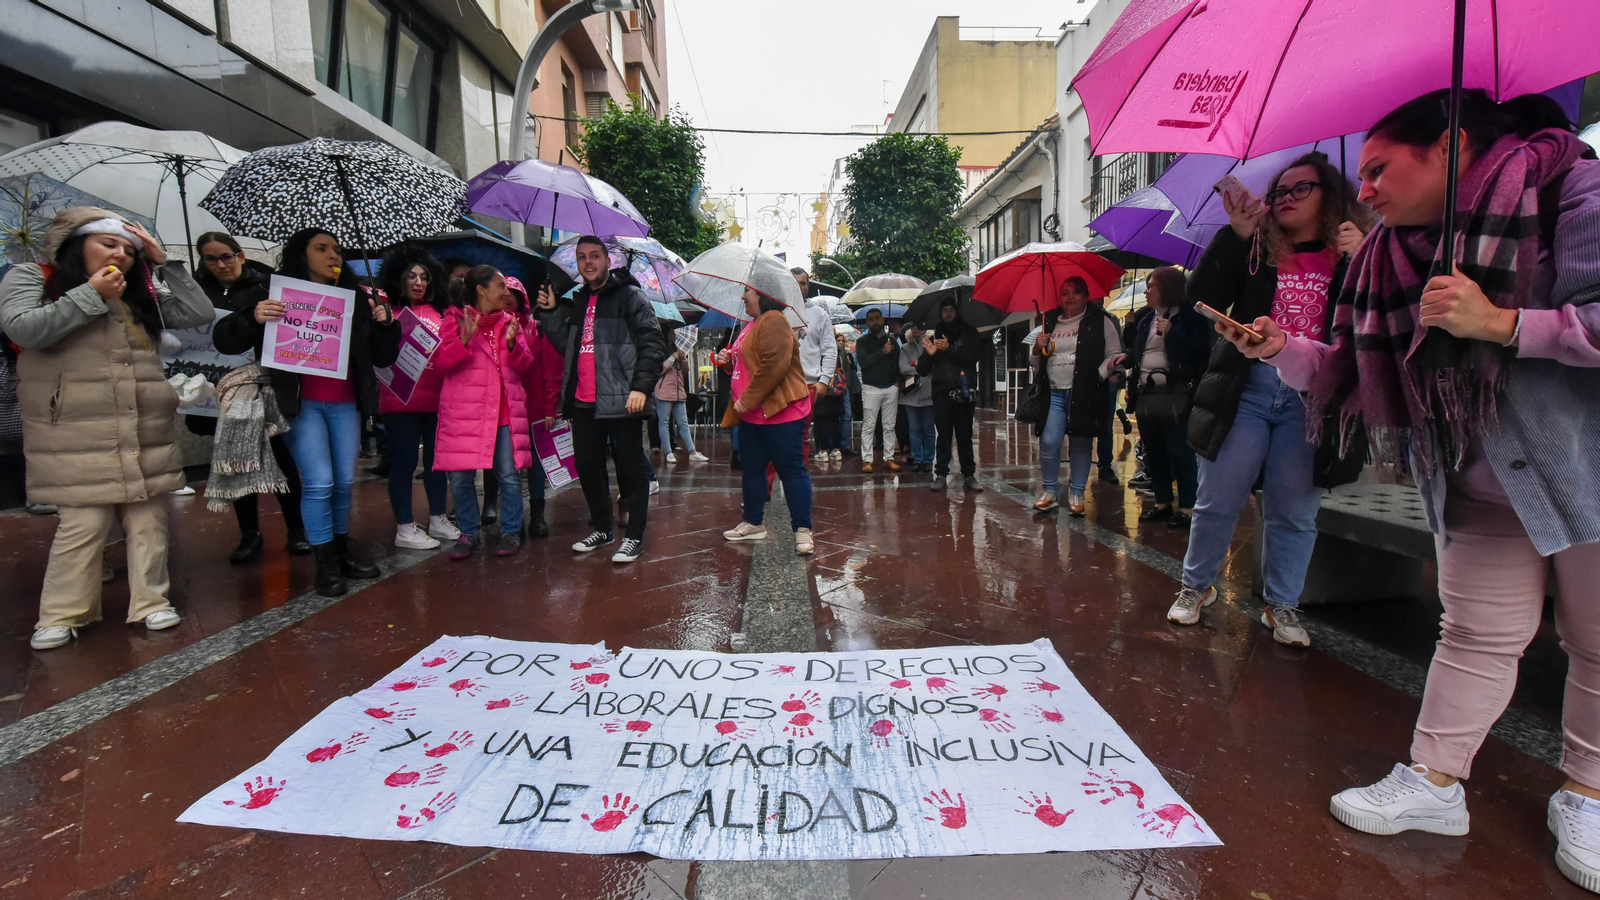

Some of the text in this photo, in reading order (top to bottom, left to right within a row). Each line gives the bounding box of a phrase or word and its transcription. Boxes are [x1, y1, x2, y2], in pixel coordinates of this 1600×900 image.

[1304, 273, 1332, 283] soluc
[282, 302, 317, 312] TENER
[283, 316, 338, 333] NO ES UN
[296, 331, 323, 343] LUJO
[280, 350, 333, 364] NECESIDAD
[304, 346, 321, 354] UNA
[447, 650, 1047, 683] POR UNOS DERECHOS
[533, 690, 777, 720] LABORALES
[379, 727, 433, 753] Y
[483, 729, 573, 762] UNA
[499, 783, 590, 825] DE
